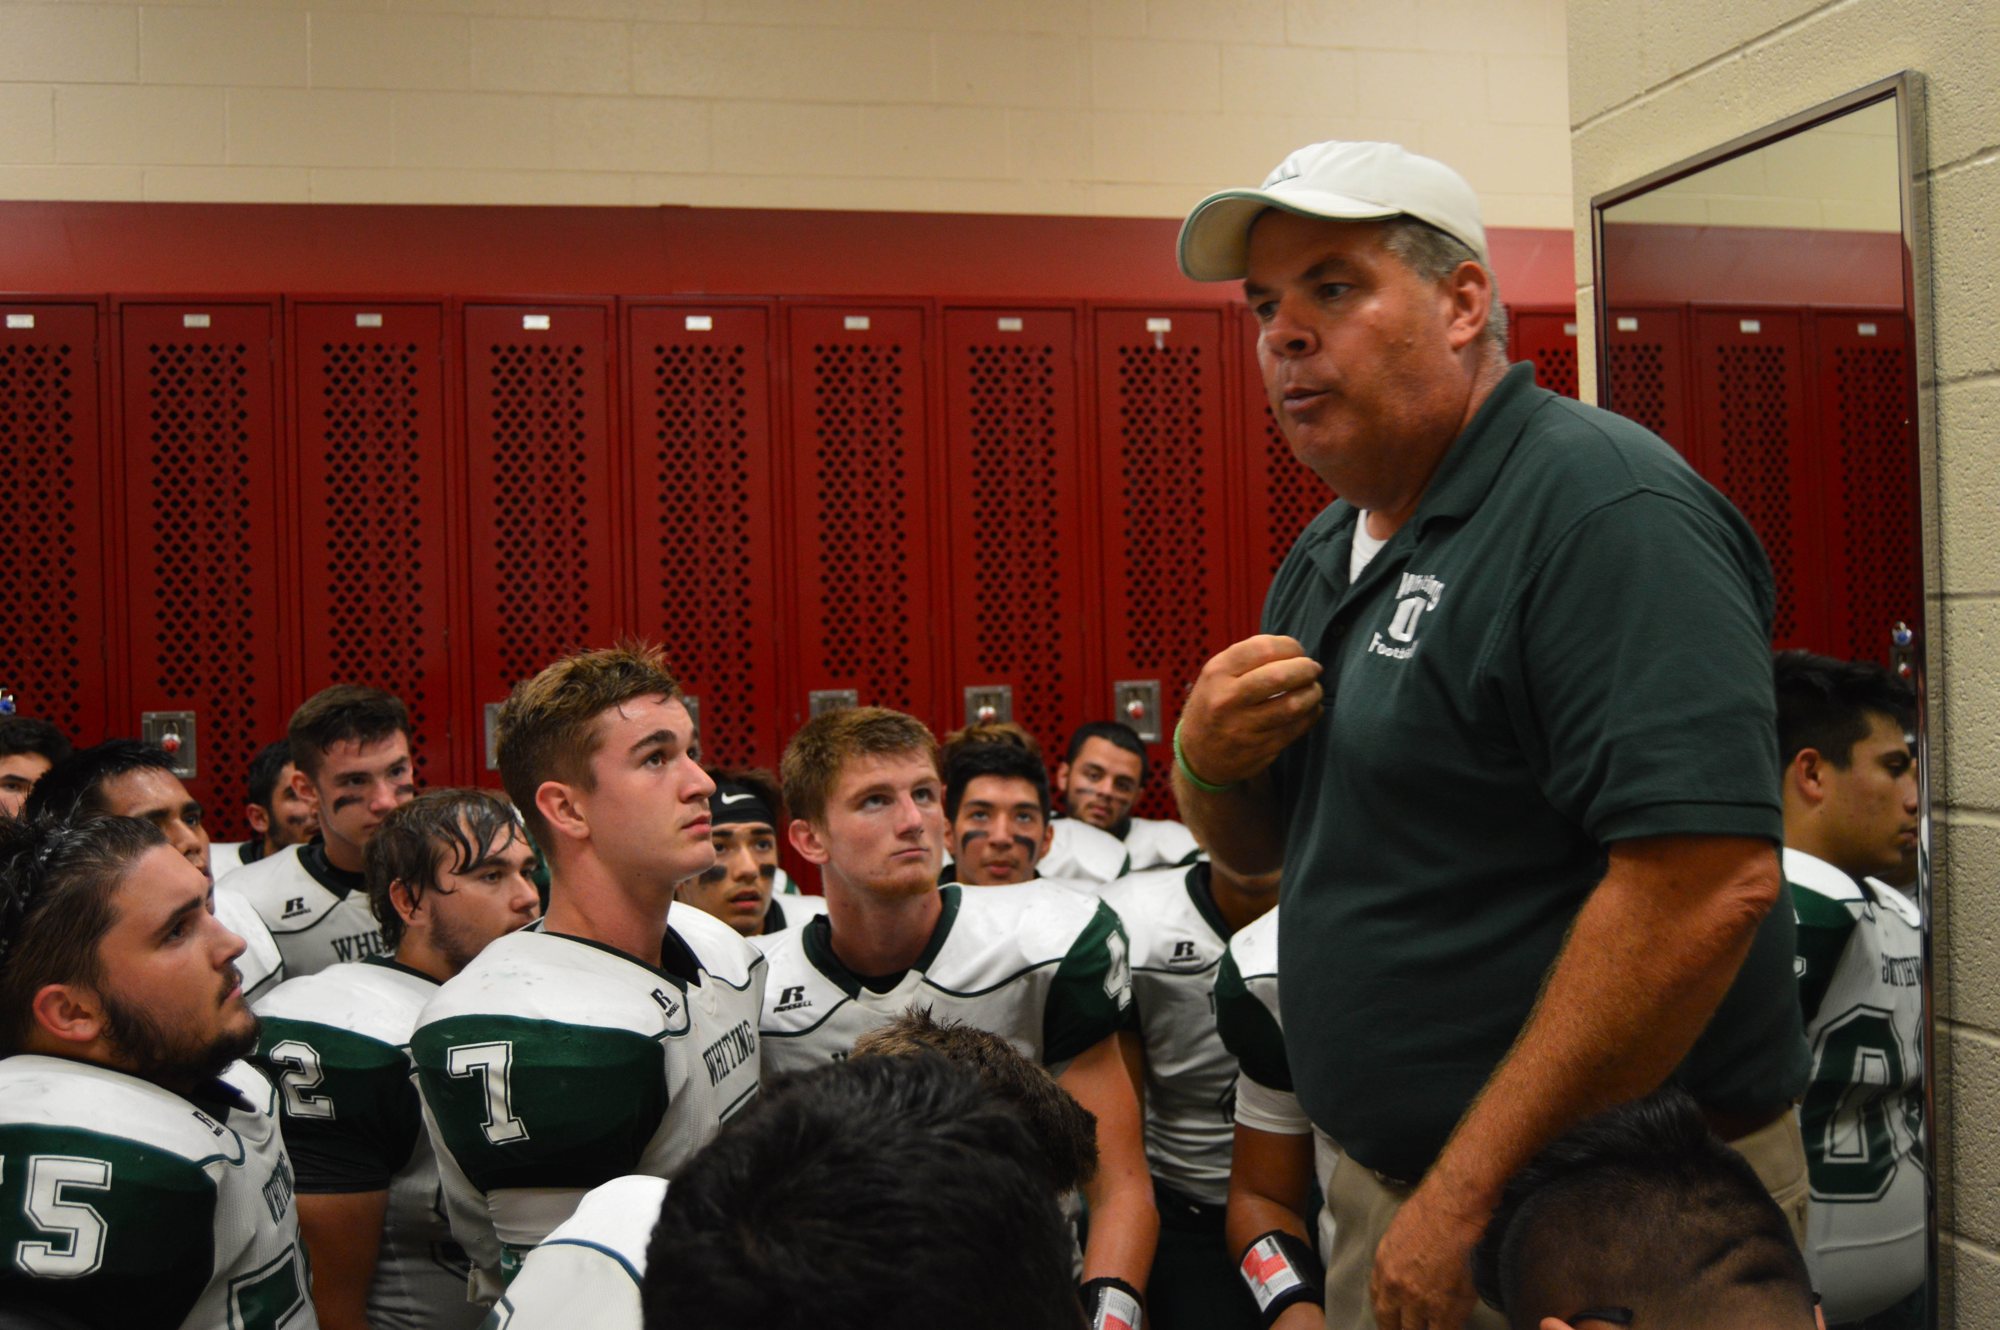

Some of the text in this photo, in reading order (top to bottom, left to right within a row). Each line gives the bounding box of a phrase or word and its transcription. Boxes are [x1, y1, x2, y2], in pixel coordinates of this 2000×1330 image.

[330, 930, 388, 962] WHI
[256, 1038, 336, 1120] 2
[447, 1040, 530, 1145] 7
[702, 1019, 755, 1088] WHITING
[0, 1154, 112, 1279] 5
